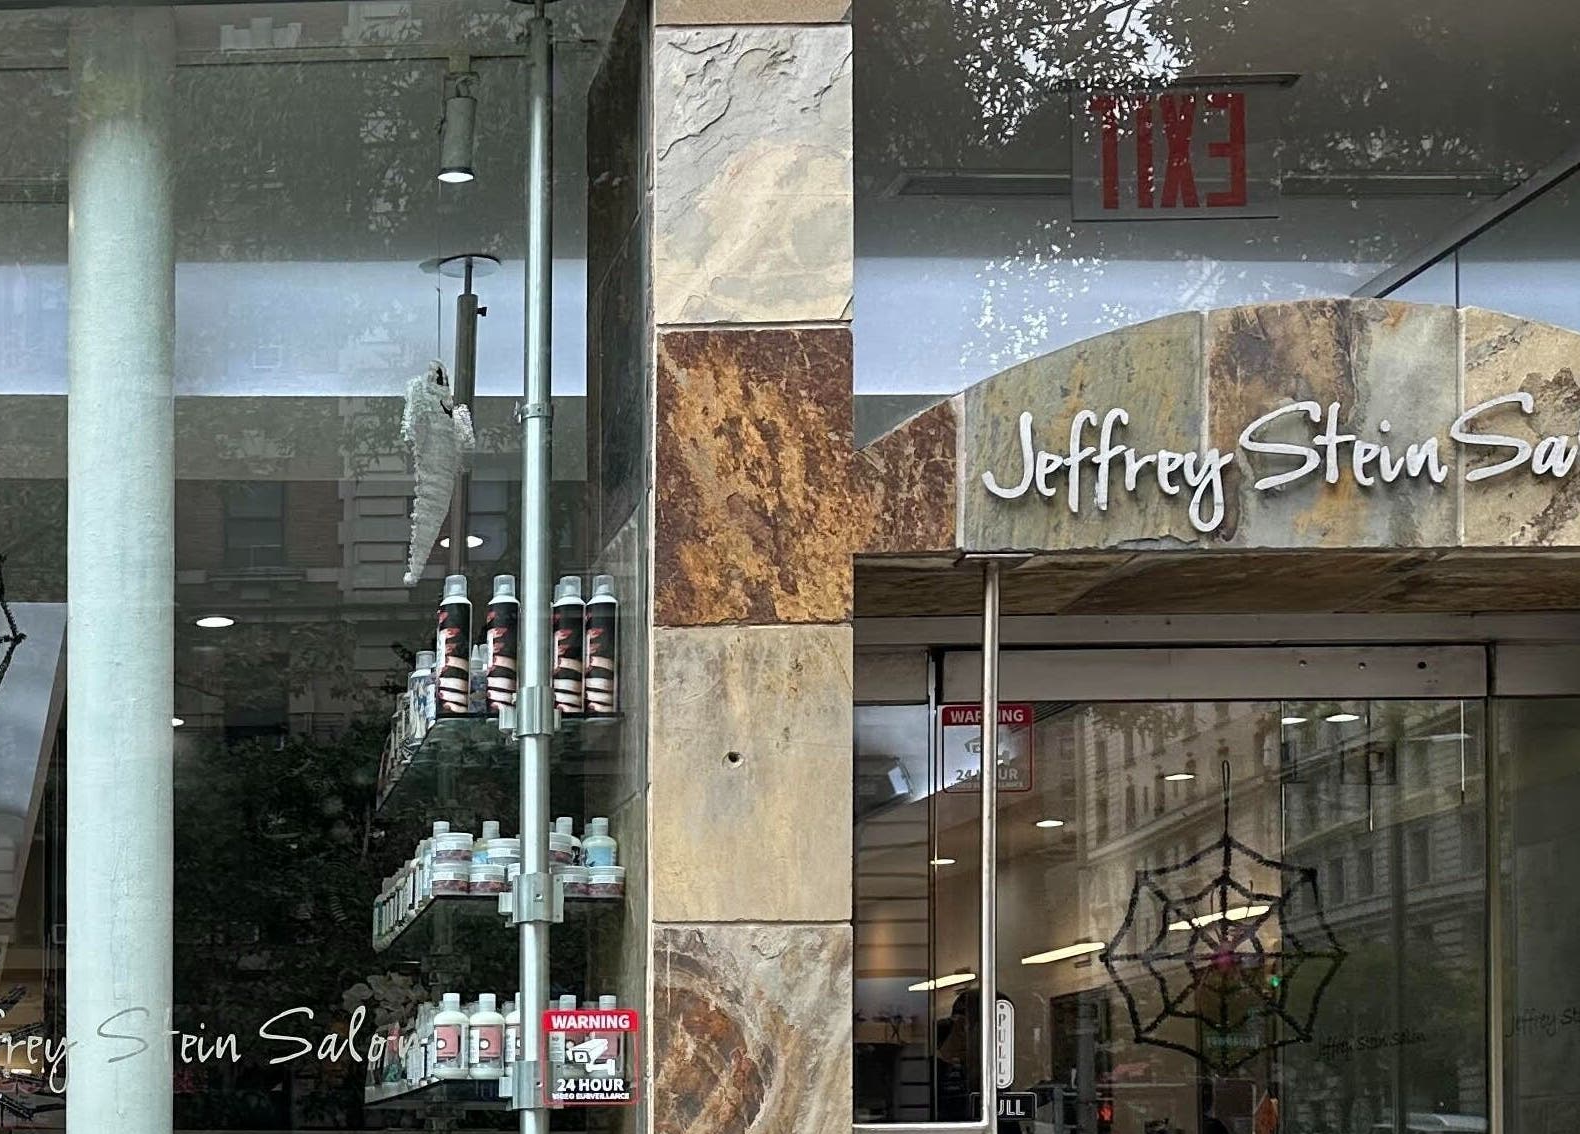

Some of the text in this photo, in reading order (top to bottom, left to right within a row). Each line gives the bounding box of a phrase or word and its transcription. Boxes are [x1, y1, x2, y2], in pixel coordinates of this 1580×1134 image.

[982, 392, 1580, 532] Jeffrey Stein Sa
[950, 709, 1024, 723] WARING
[551, 1014, 630, 1029] WARNING
[97, 1005, 241, 1065] Stein
[258, 1005, 429, 1065] Salon
[998, 1013, 1007, 1075] PULL
[556, 1078, 624, 1092] 24 HOUR
[551, 1092, 630, 1100] VIDEO SURVEILLANCE
